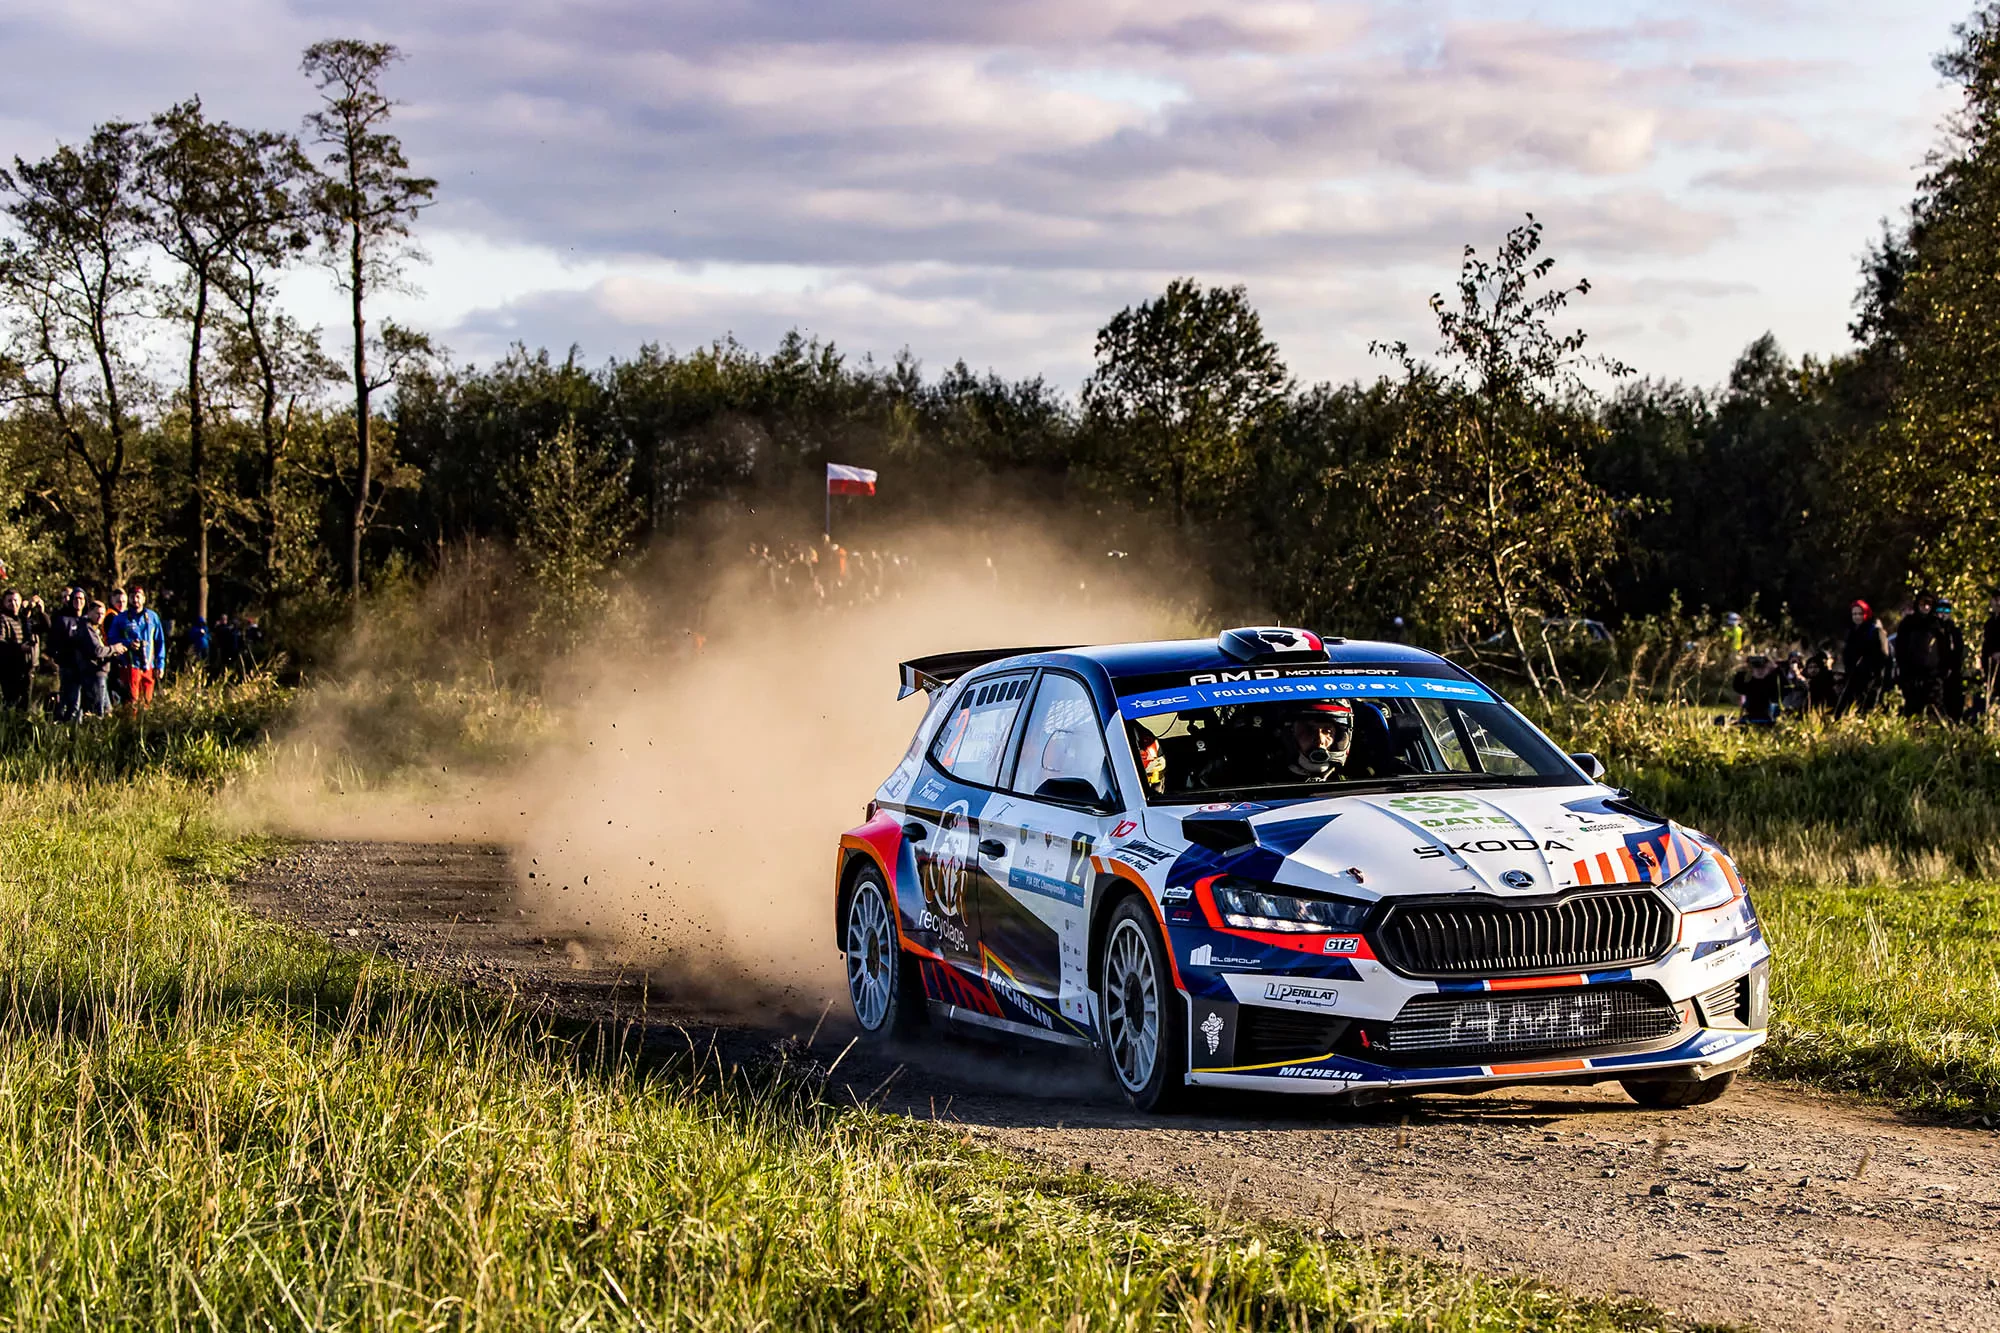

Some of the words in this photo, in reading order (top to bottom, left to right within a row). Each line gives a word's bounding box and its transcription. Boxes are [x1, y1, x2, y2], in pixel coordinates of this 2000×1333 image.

[1189, 669, 1280, 686] AMD
[1285, 668, 1399, 676] MOTORSPORT
[1213, 687, 1270, 698] FOLLOW
[1273, 685, 1293, 693] US
[1296, 684, 1317, 692] ON
[942, 708, 970, 767] 2
[1070, 835, 1087, 885] 2
[1412, 839, 1574, 860] SKODA
[919, 909, 969, 952] recyclage.
[990, 971, 1054, 1030] MICHELIN
[1449, 991, 1612, 1043] AMD
[1278, 1067, 1363, 1080] MICHELIN
